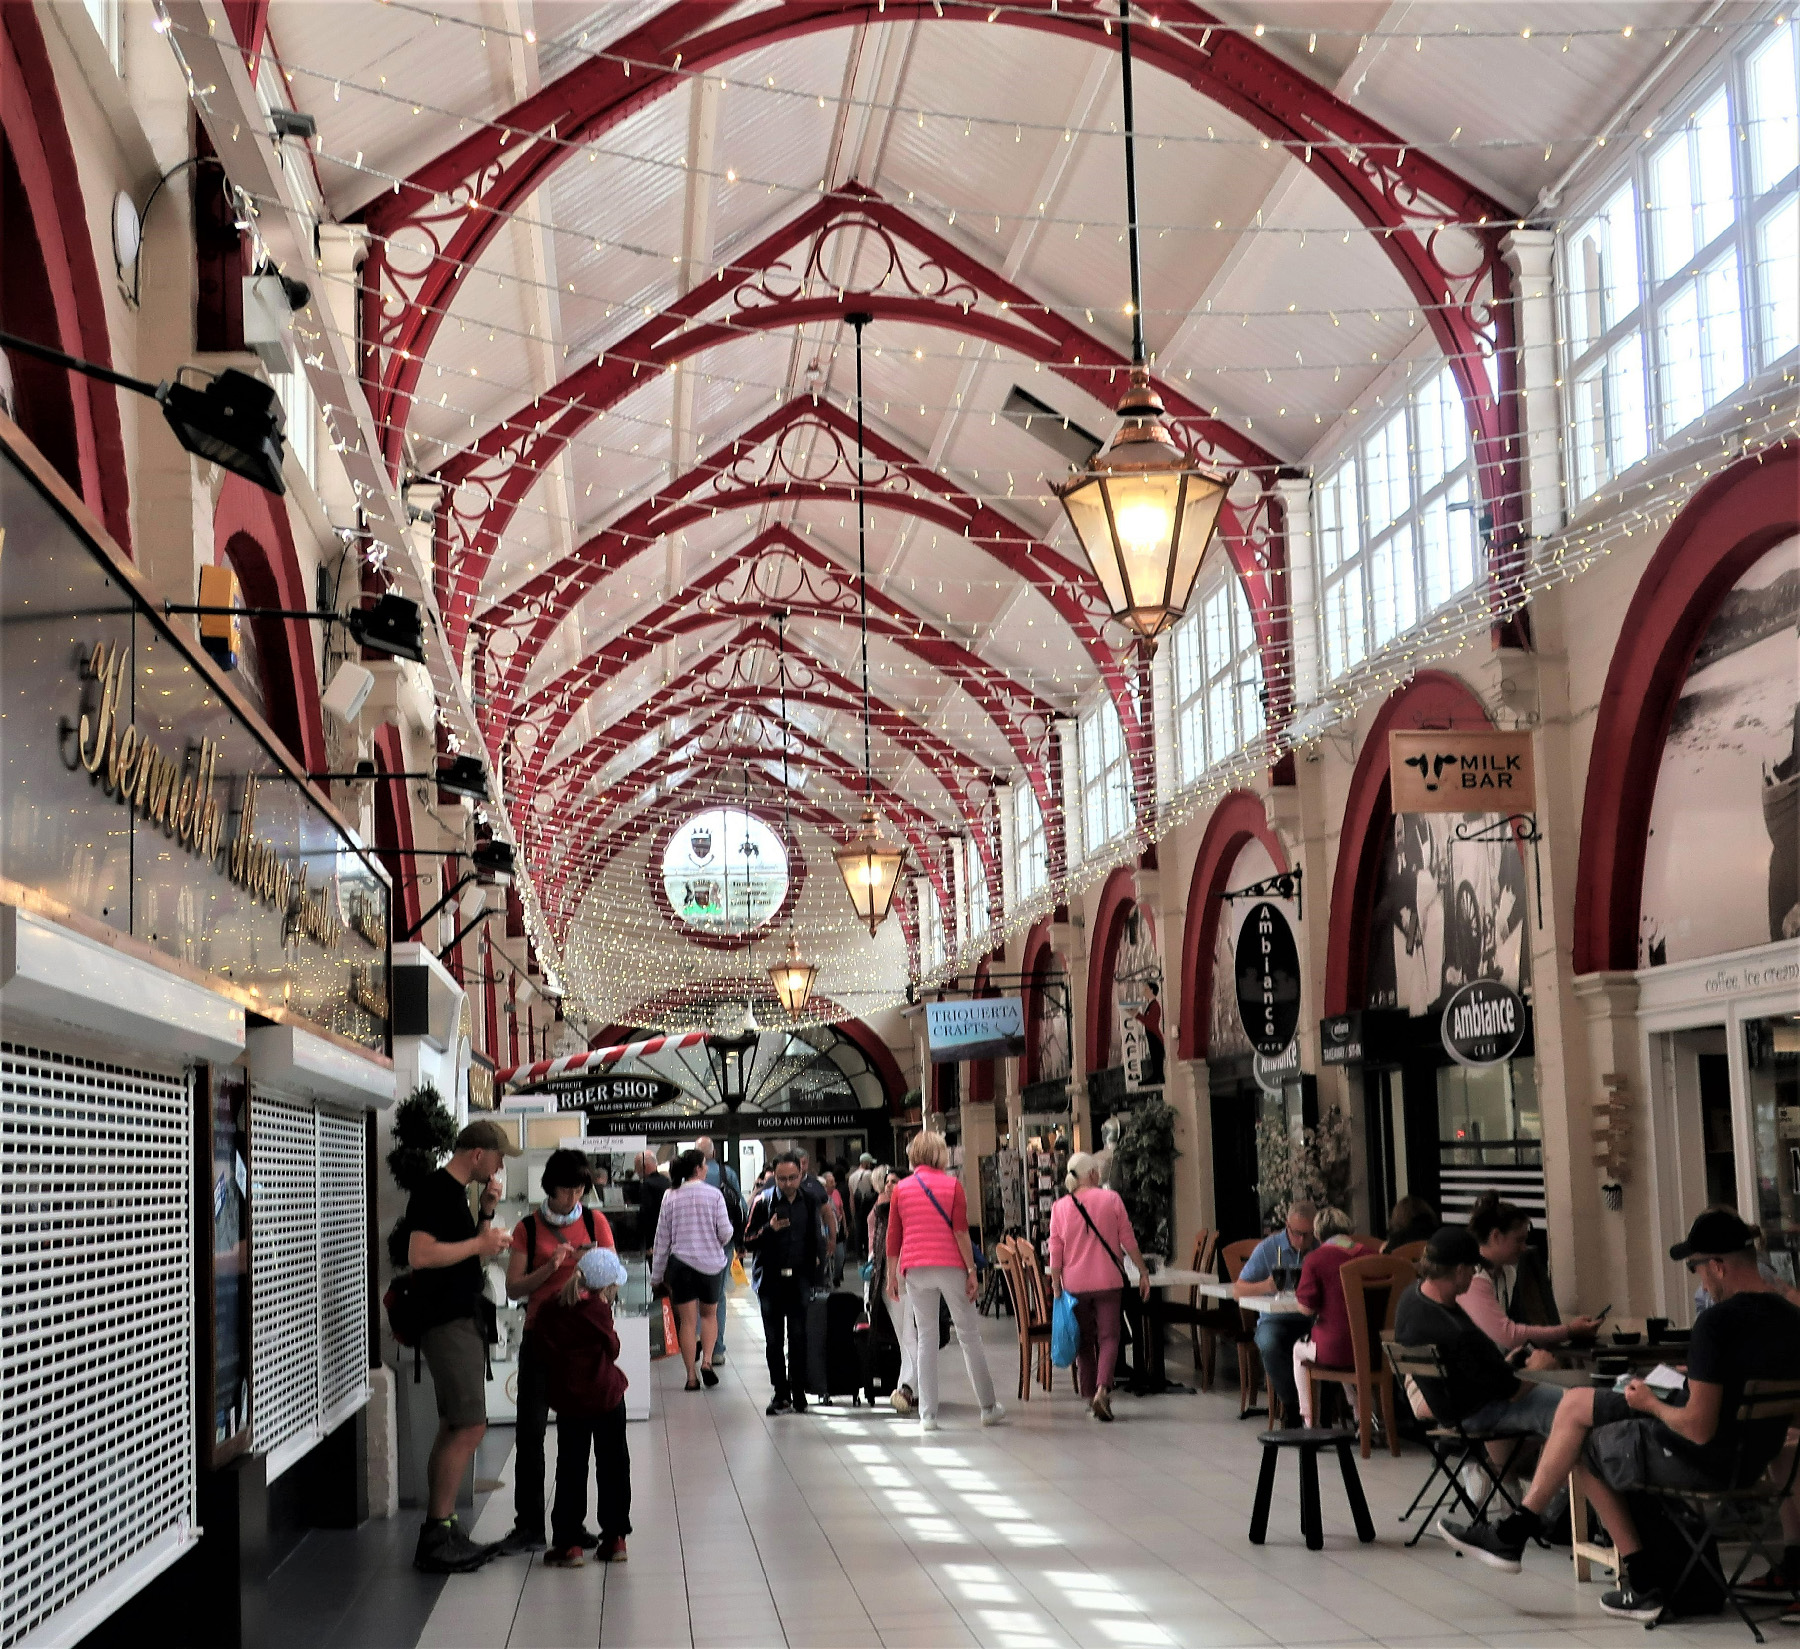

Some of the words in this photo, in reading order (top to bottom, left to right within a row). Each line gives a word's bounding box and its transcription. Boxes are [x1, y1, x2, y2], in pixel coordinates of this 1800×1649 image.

[1461, 755, 1521, 770] MILK
[1462, 773, 1513, 788] BAR
[1259, 905, 1275, 1036] Ambiance
[932, 1006, 1018, 1022] TRIQUERTA
[1455, 990, 1515, 1040] Ambiance
[934, 1021, 989, 1037] CRAFTS
[1124, 1018, 1138, 1072] CAFE
[547, 1081, 582, 1091] UPPERCUT
[535, 1084, 608, 1110] RBER
[613, 1081, 658, 1099] SHOP
[624, 1101, 653, 1110] WELCOME
[609, 1123, 627, 1132] THE
[628, 1120, 676, 1132] VICTORIAN
[678, 1119, 714, 1130] MARKET
[757, 1117, 782, 1128] FOOD
[783, 1116, 802, 1126] AND
[804, 1115, 831, 1125] DRINK
